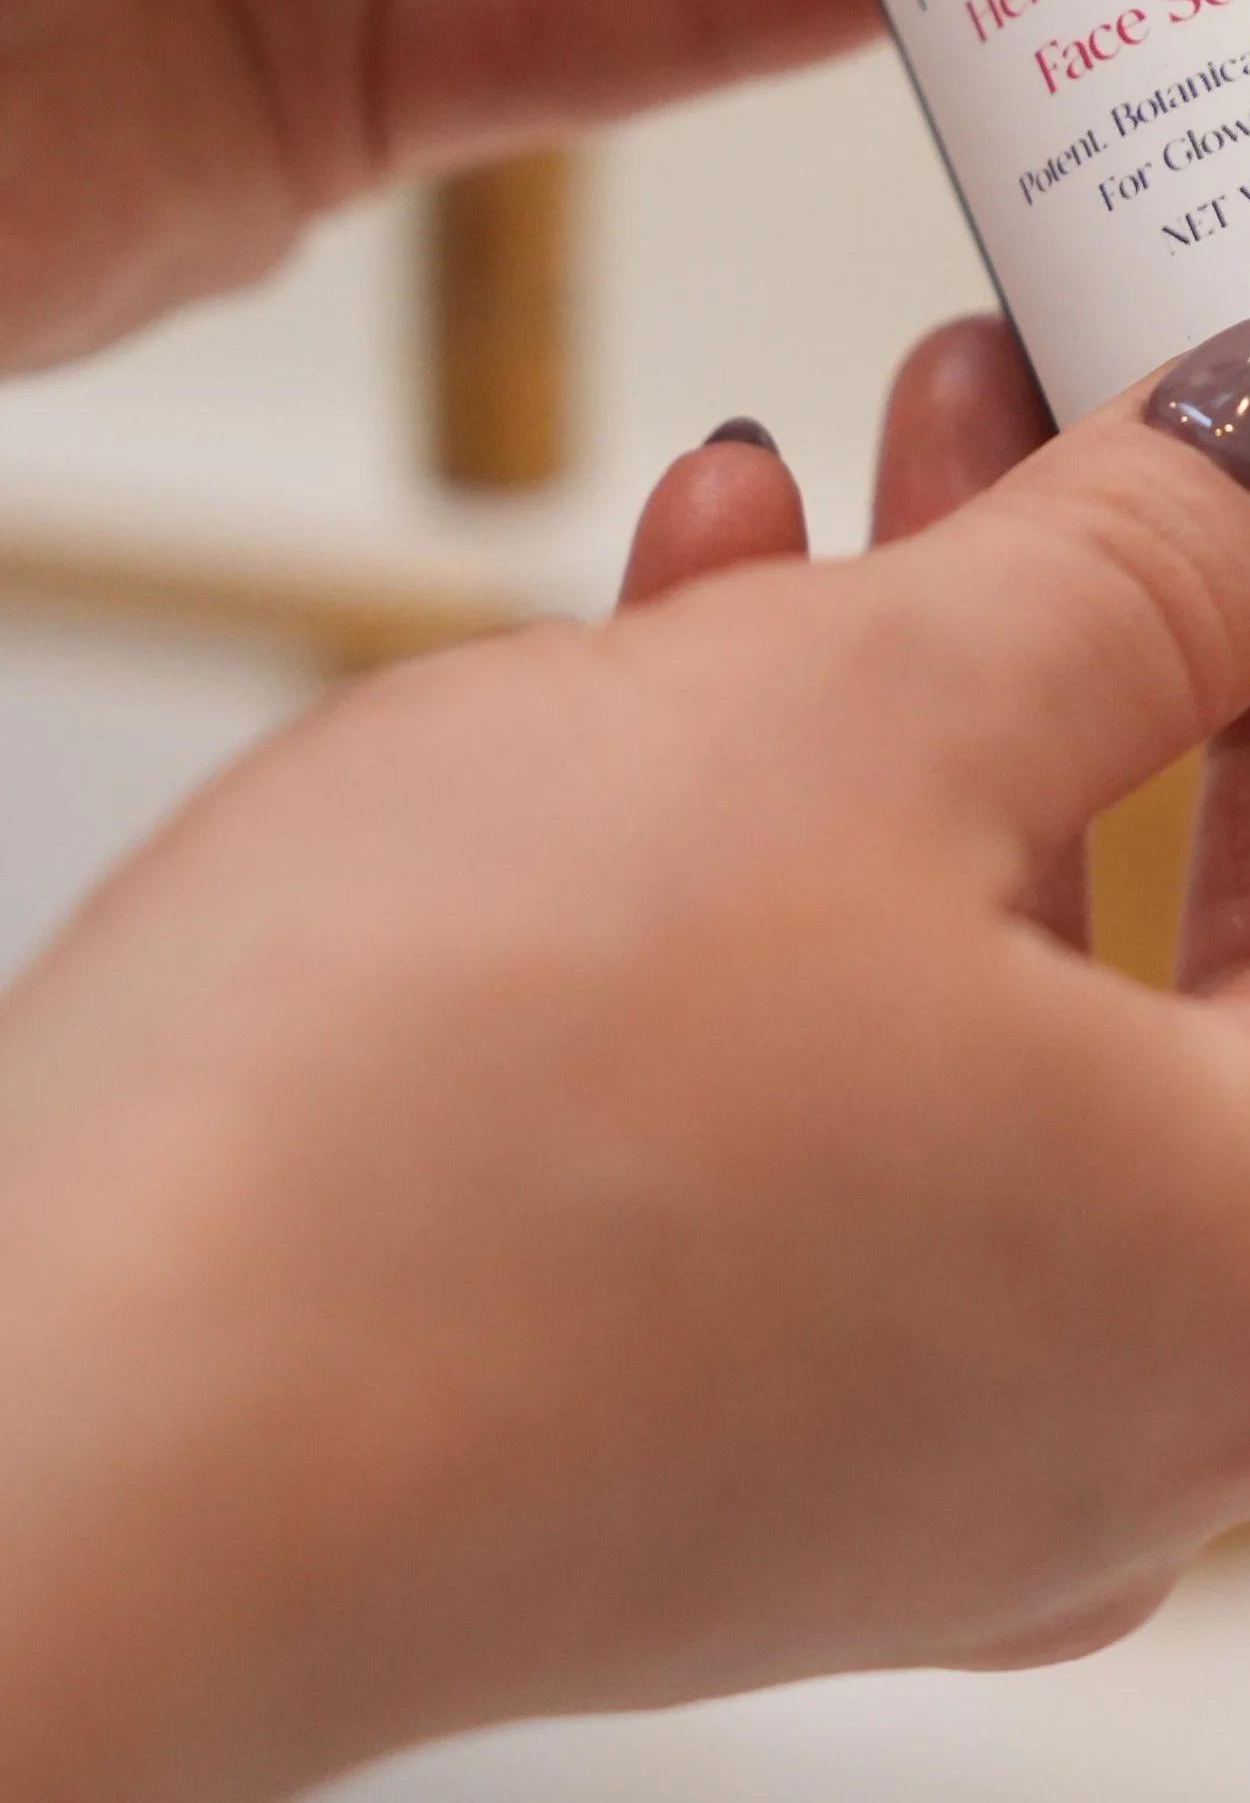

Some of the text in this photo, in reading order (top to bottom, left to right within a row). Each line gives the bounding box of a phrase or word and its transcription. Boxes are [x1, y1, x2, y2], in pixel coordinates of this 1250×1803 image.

[1034, 8, 1151, 95] Face
[1018, 129, 1108, 207] Potent.
[1098, 162, 1153, 212] For
[1162, 194, 1227, 256] NET
